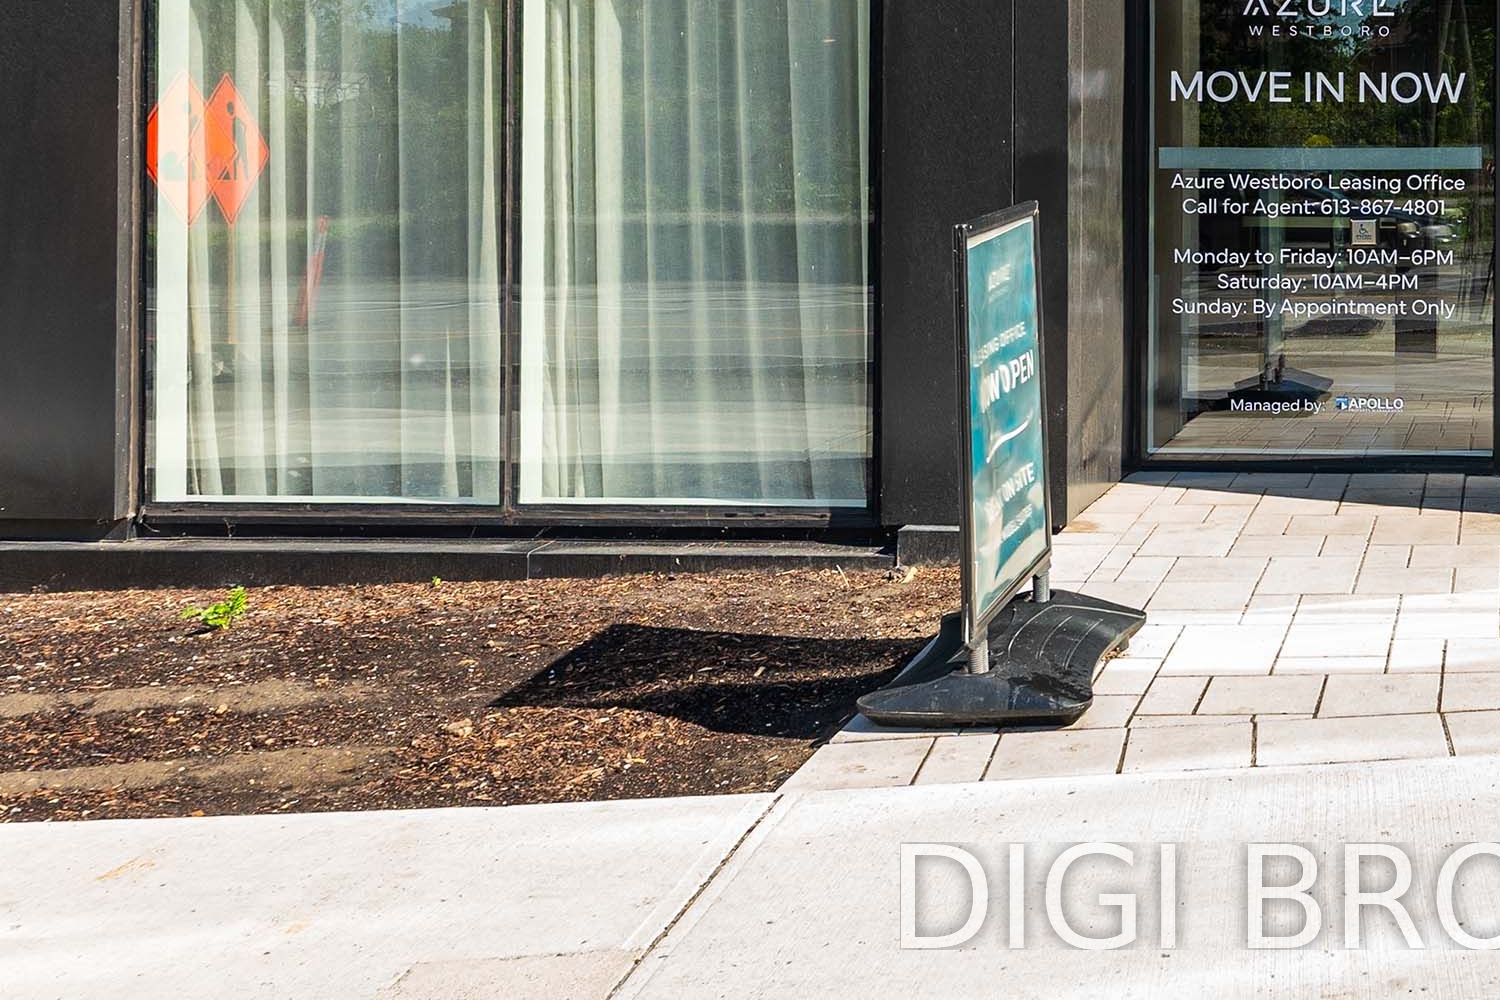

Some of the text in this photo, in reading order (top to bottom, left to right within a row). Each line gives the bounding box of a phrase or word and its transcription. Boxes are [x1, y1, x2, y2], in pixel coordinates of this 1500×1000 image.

[1248, 25, 1390, 37] WESTBORO
[1170, 70, 1466, 104] MOVE IN NOW
[1171, 173, 1466, 193] Azure Westboro Leasing Office
[1182, 198, 1446, 218] Call for Agent: 613-867-4801
[1173, 249, 1251, 268] Monday
[1255, 251, 1274, 265] to
[1279, 249, 1342, 268] Friday:
[1217, 273, 1307, 292] Saturday:
[1172, 298, 1456, 319] Sunday: By Appointment Only
[998, 349, 1034, 394] OPEN
[1230, 398, 1404, 415] Managed by: APOLLO
